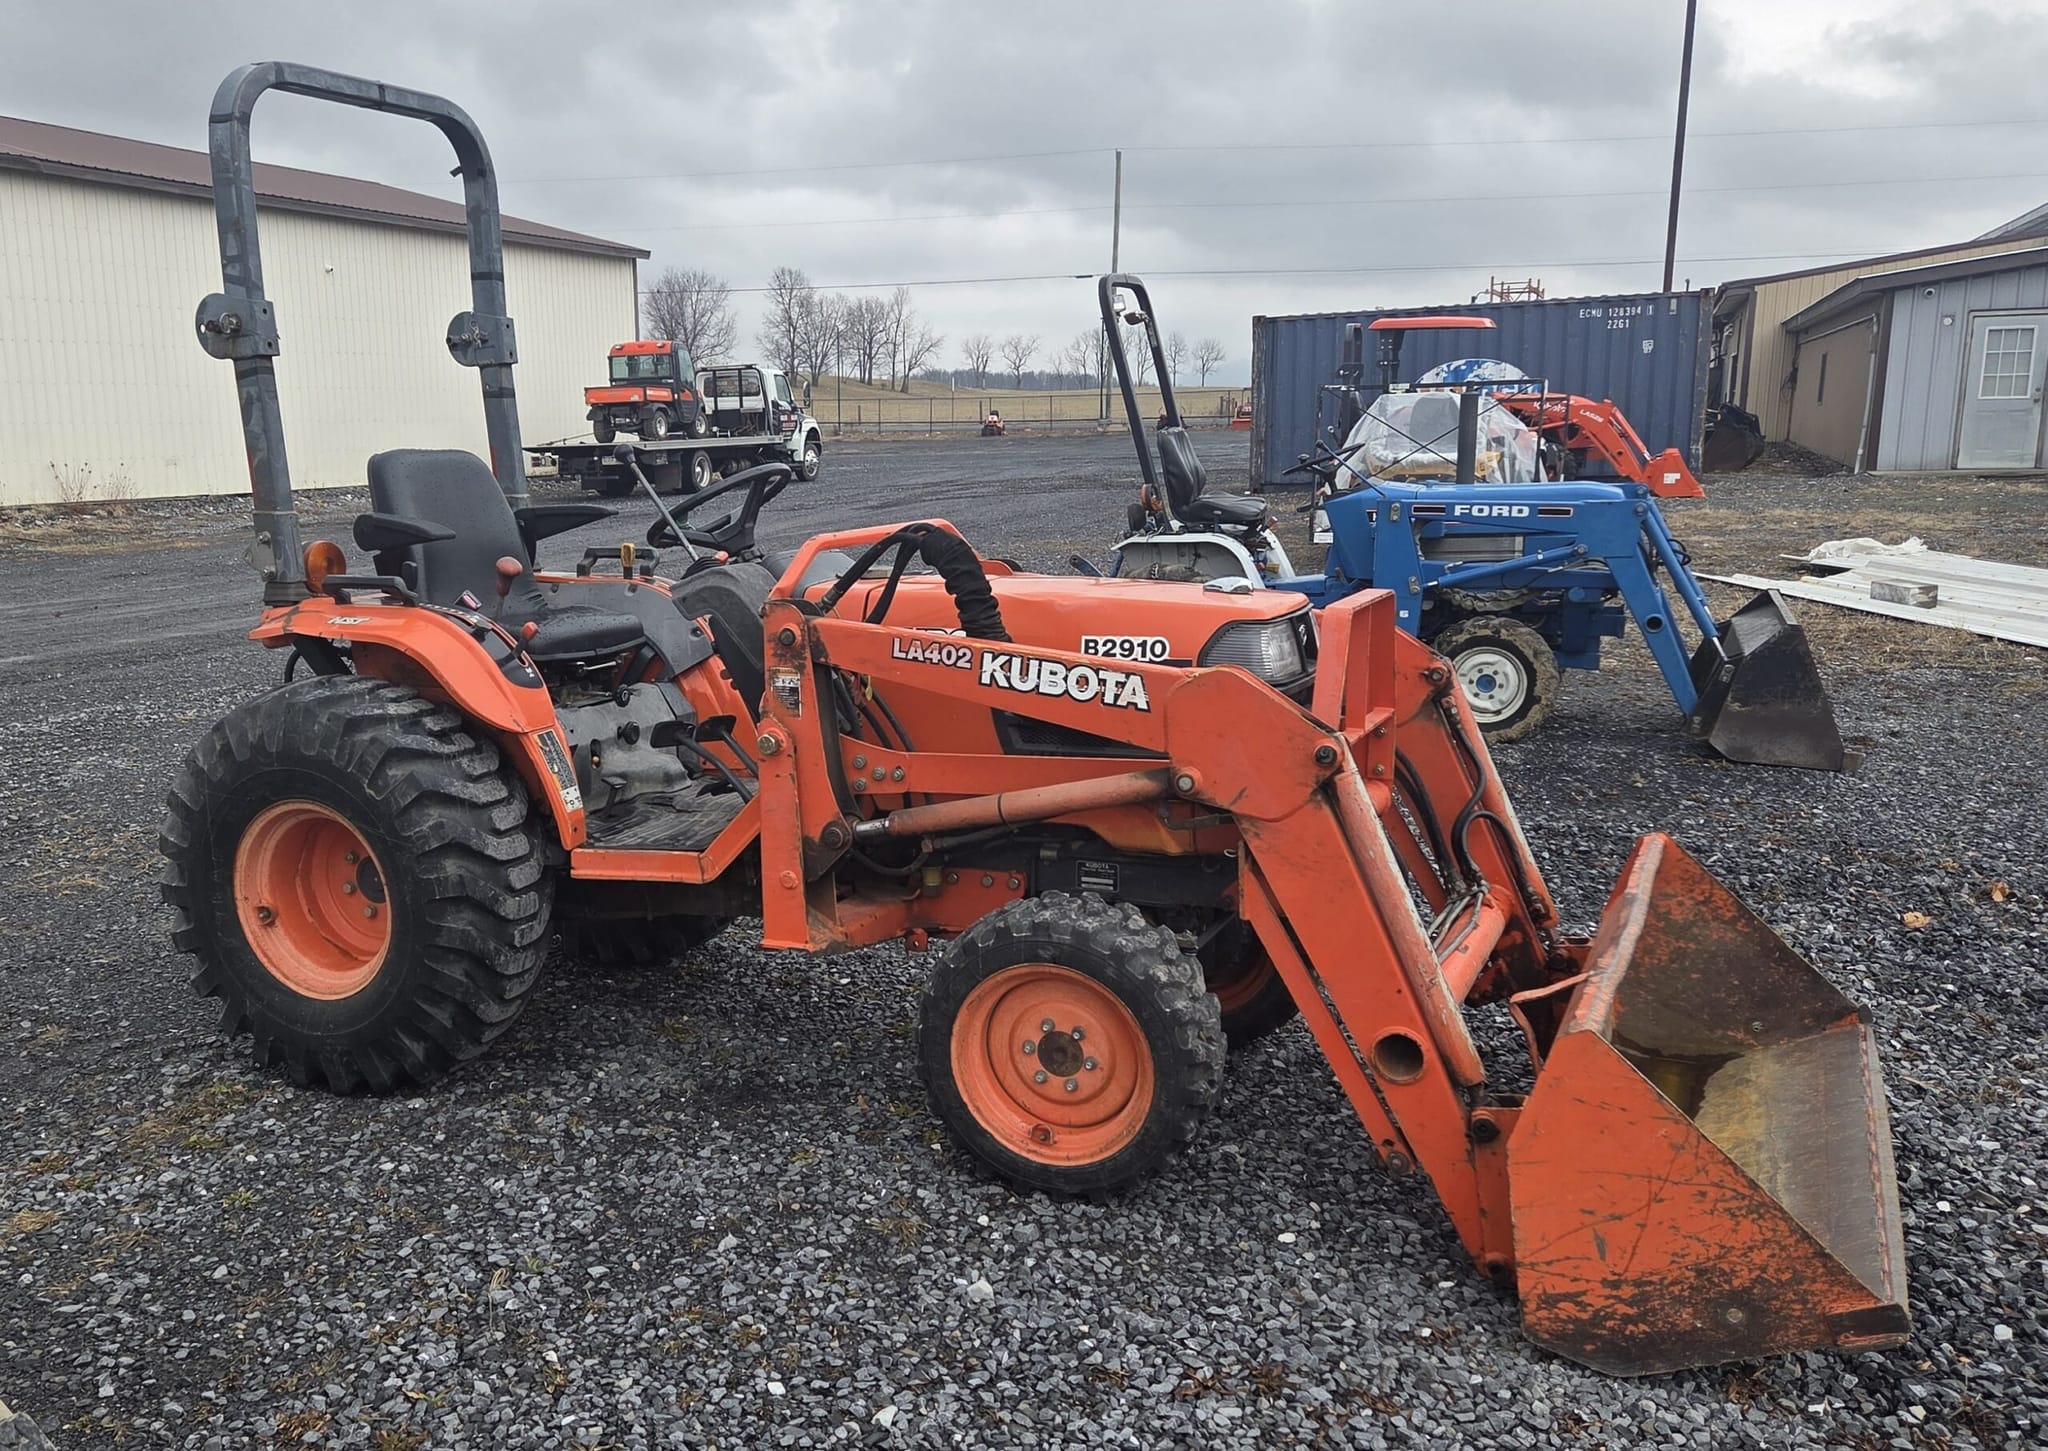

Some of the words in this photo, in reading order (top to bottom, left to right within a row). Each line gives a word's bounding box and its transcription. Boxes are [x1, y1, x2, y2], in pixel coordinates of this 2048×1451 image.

[1579, 307, 1603, 319] ECMU
[1608, 305, 1642, 317] 128394
[1607, 319, 1630, 329] 22G1
[1454, 504, 1530, 518] FORD
[1083, 637, 1168, 659] B2910
[892, 637, 973, 669] LA402
[980, 651, 1149, 710] KUBOTA
